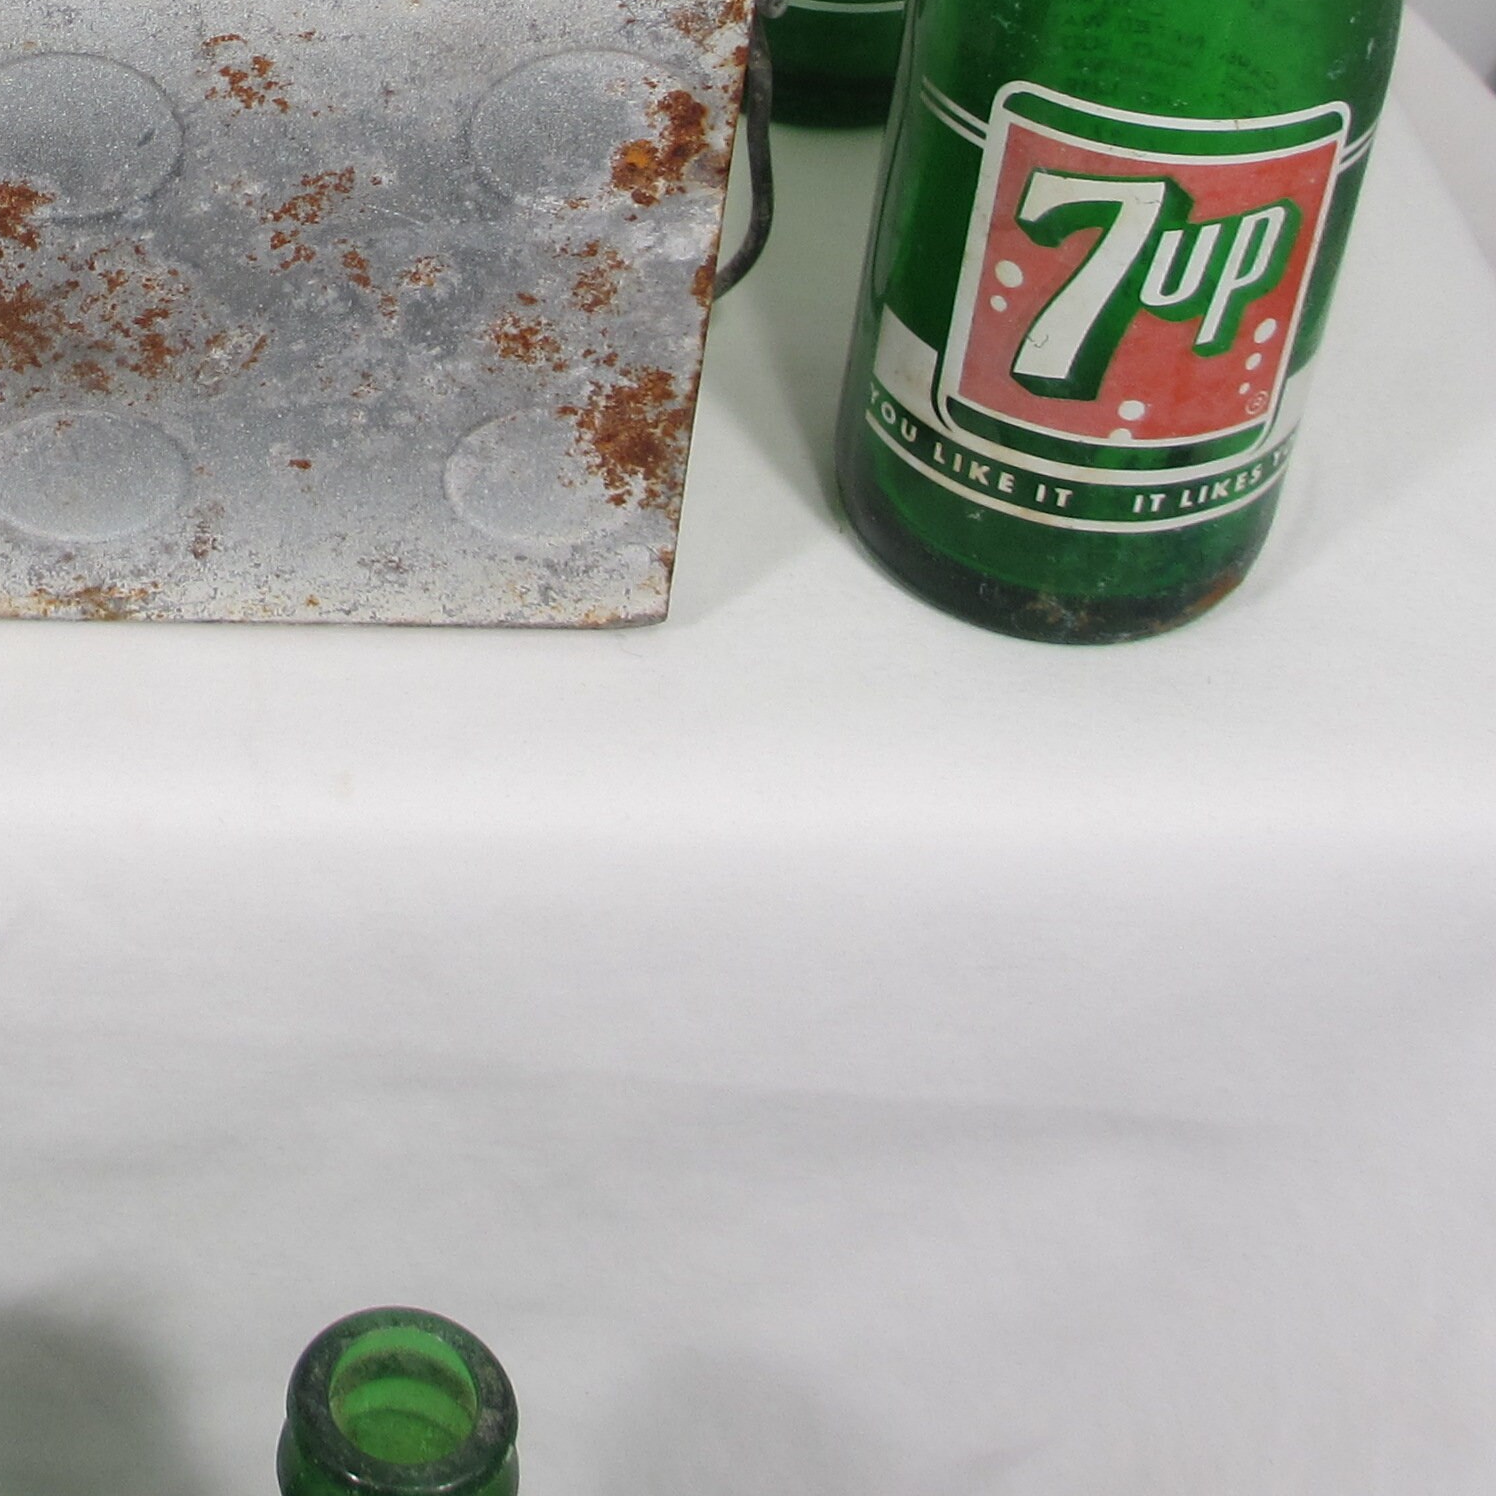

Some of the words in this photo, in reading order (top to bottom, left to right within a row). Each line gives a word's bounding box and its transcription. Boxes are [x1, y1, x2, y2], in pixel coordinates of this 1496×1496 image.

[869, 381, 919, 444] YOU
[934, 441, 1015, 492] LIKE
[1035, 482, 1074, 508] IT
[1132, 493, 1166, 514] IT
[1179, 463, 1264, 509] LIKES
